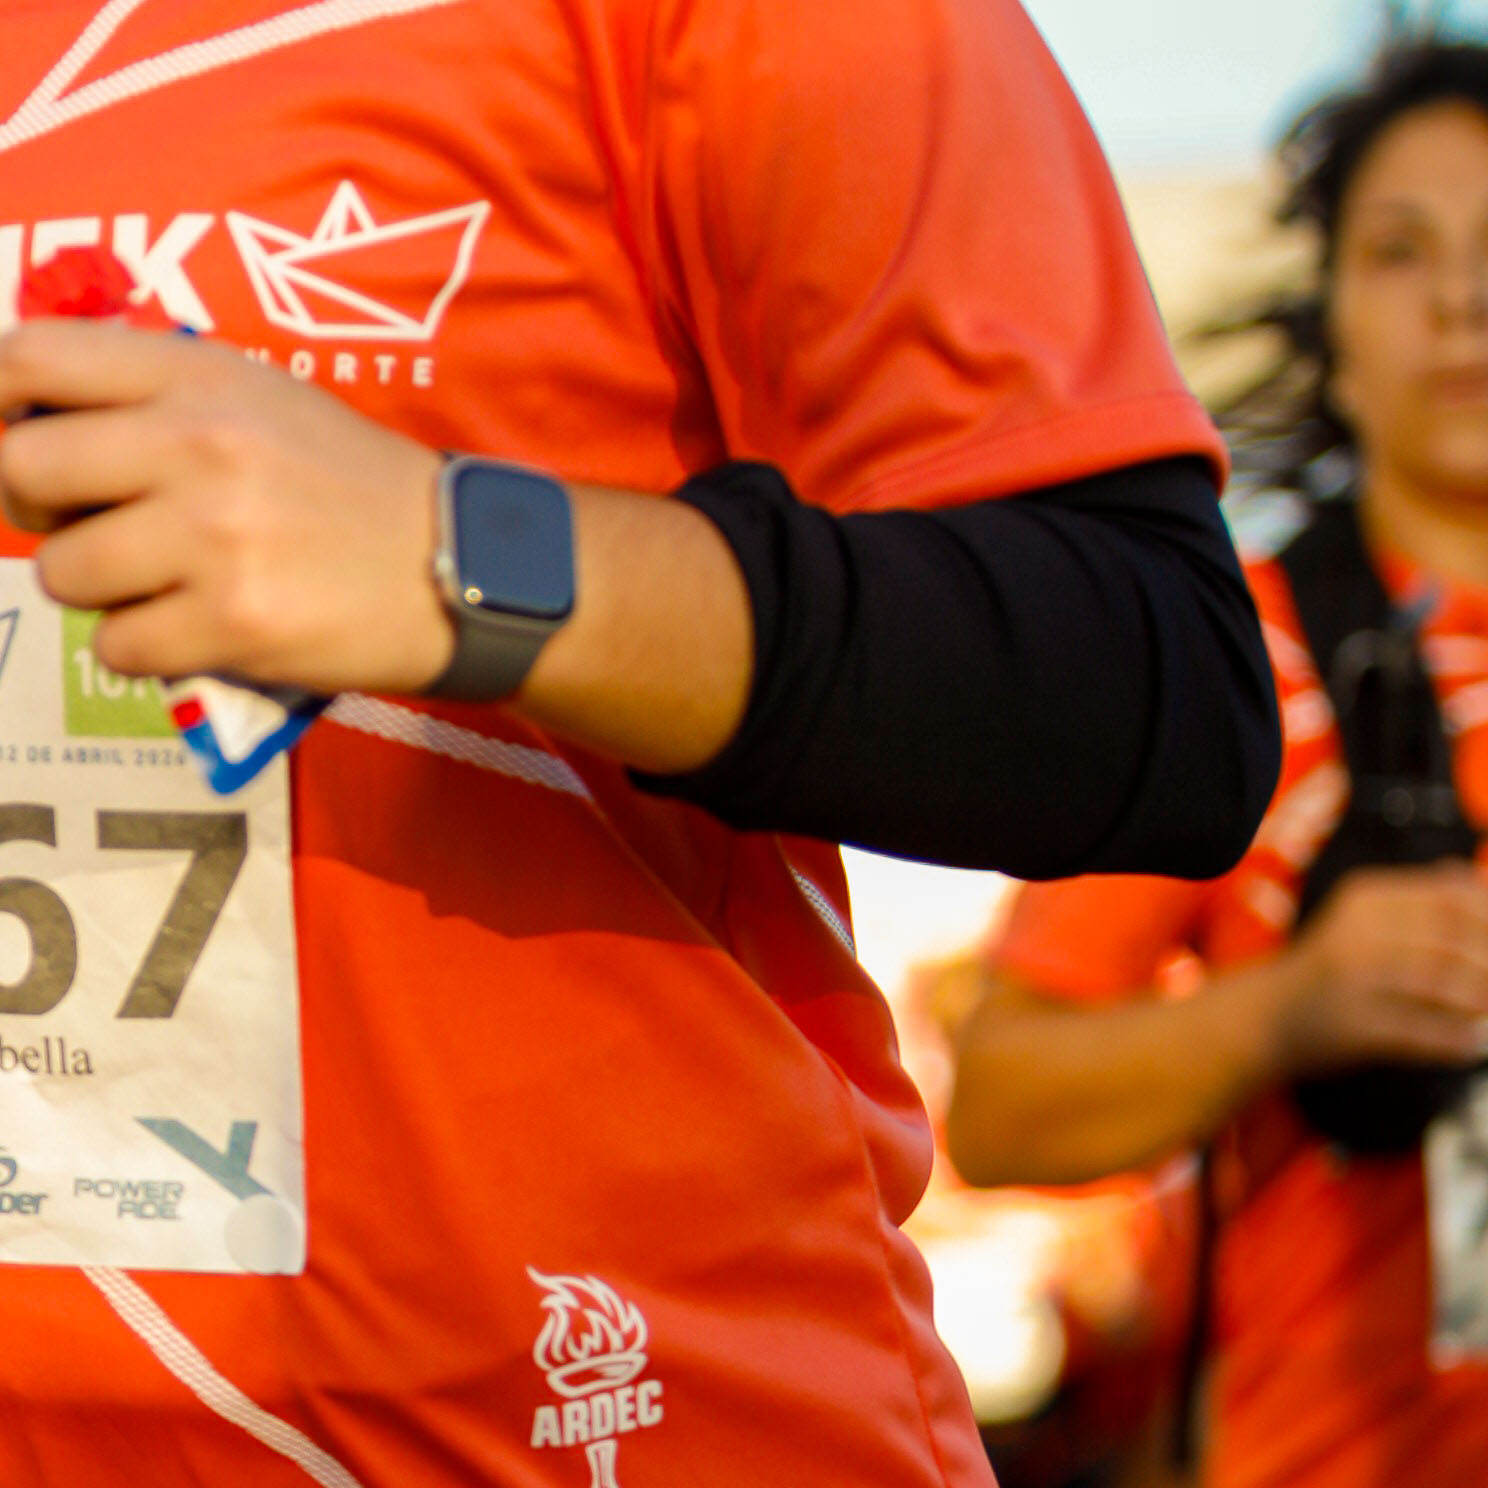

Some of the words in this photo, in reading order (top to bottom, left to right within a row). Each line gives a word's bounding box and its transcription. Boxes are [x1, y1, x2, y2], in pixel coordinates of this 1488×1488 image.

[26, 745, 52, 763] DE
[62, 748, 123, 765] ABRIL
[73, 1177, 184, 1200] POWER
[531, 1380, 664, 1448] ARDEC
